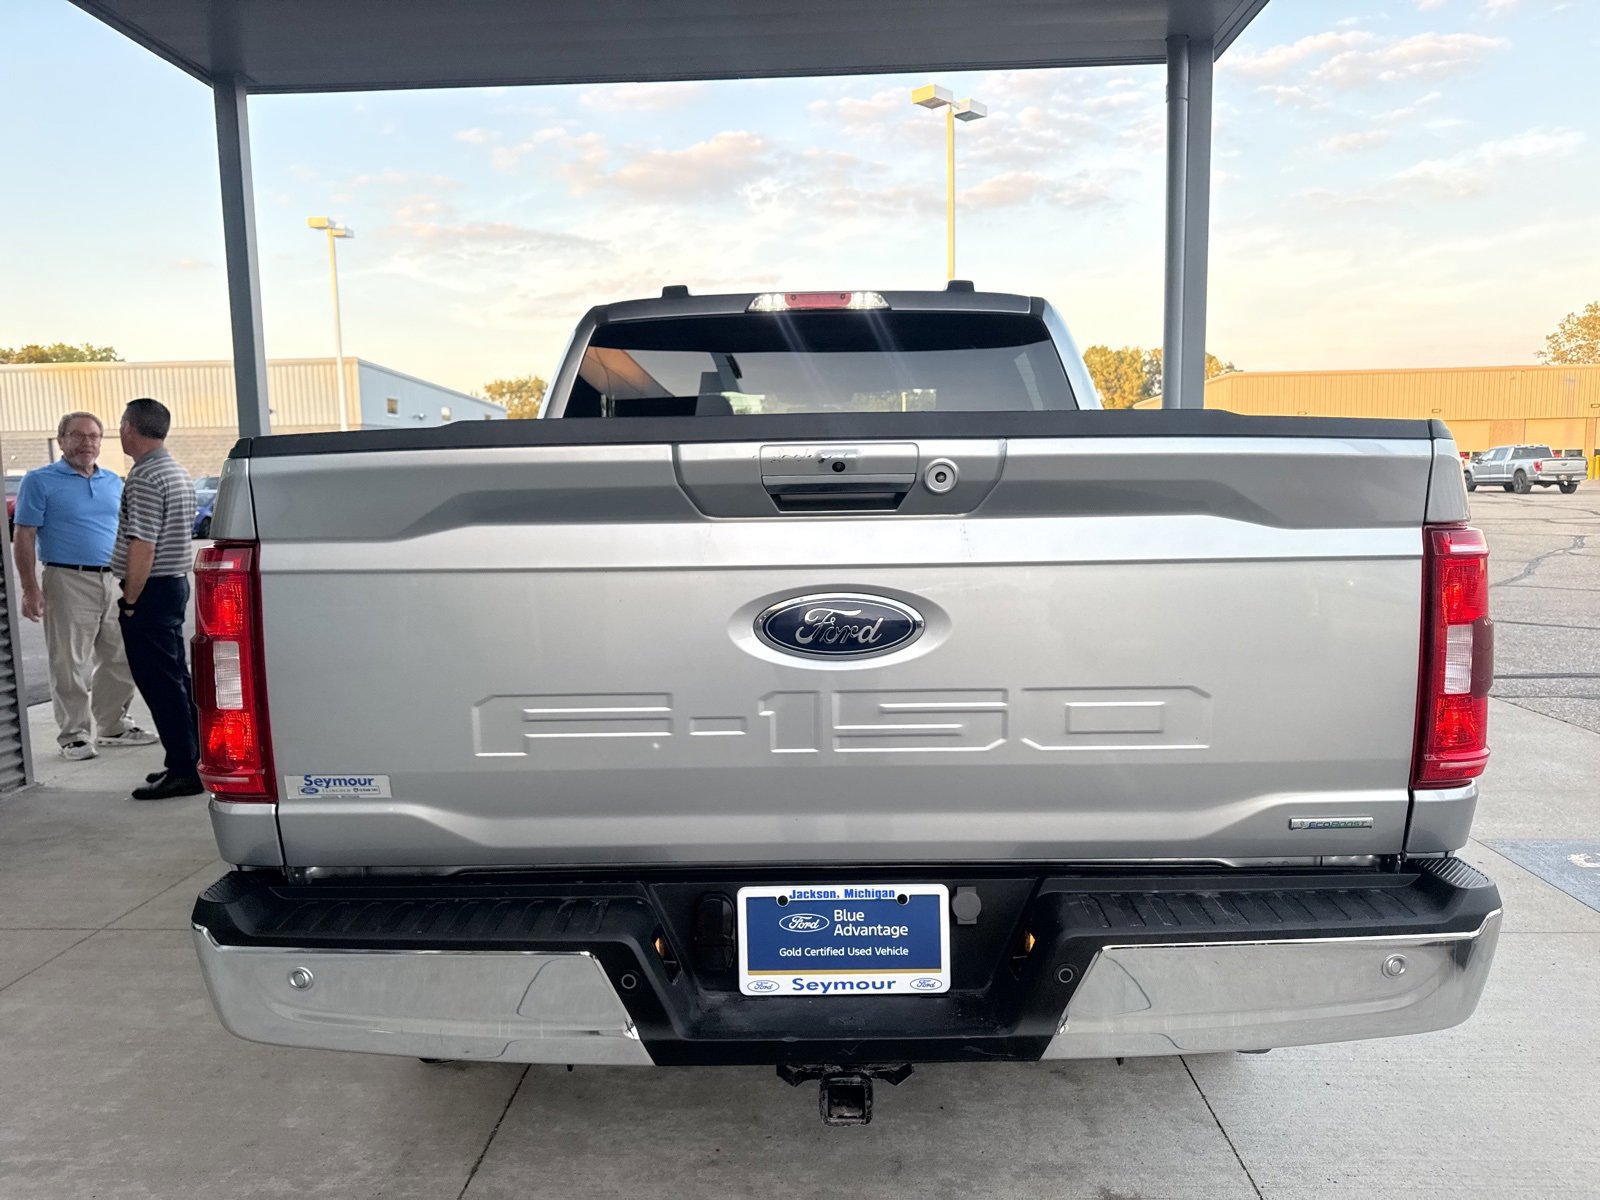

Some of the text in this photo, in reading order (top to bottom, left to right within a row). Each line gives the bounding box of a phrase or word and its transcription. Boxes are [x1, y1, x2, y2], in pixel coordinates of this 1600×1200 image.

[795, 607, 884, 644] Ford
[472, 685, 1212, 757] F-150
[304, 775, 374, 788] Seymour
[789, 888, 895, 900] Jackson, Michigan
[834, 909, 865, 922] Blue
[788, 916, 820, 930] Ford
[834, 923, 908, 938] Advantage
[779, 946, 909, 957] Gold Certified Used Vehicle
[753, 981, 774, 991] Ford
[792, 977, 897, 994] Seymour
[915, 979, 936, 989] Ford
